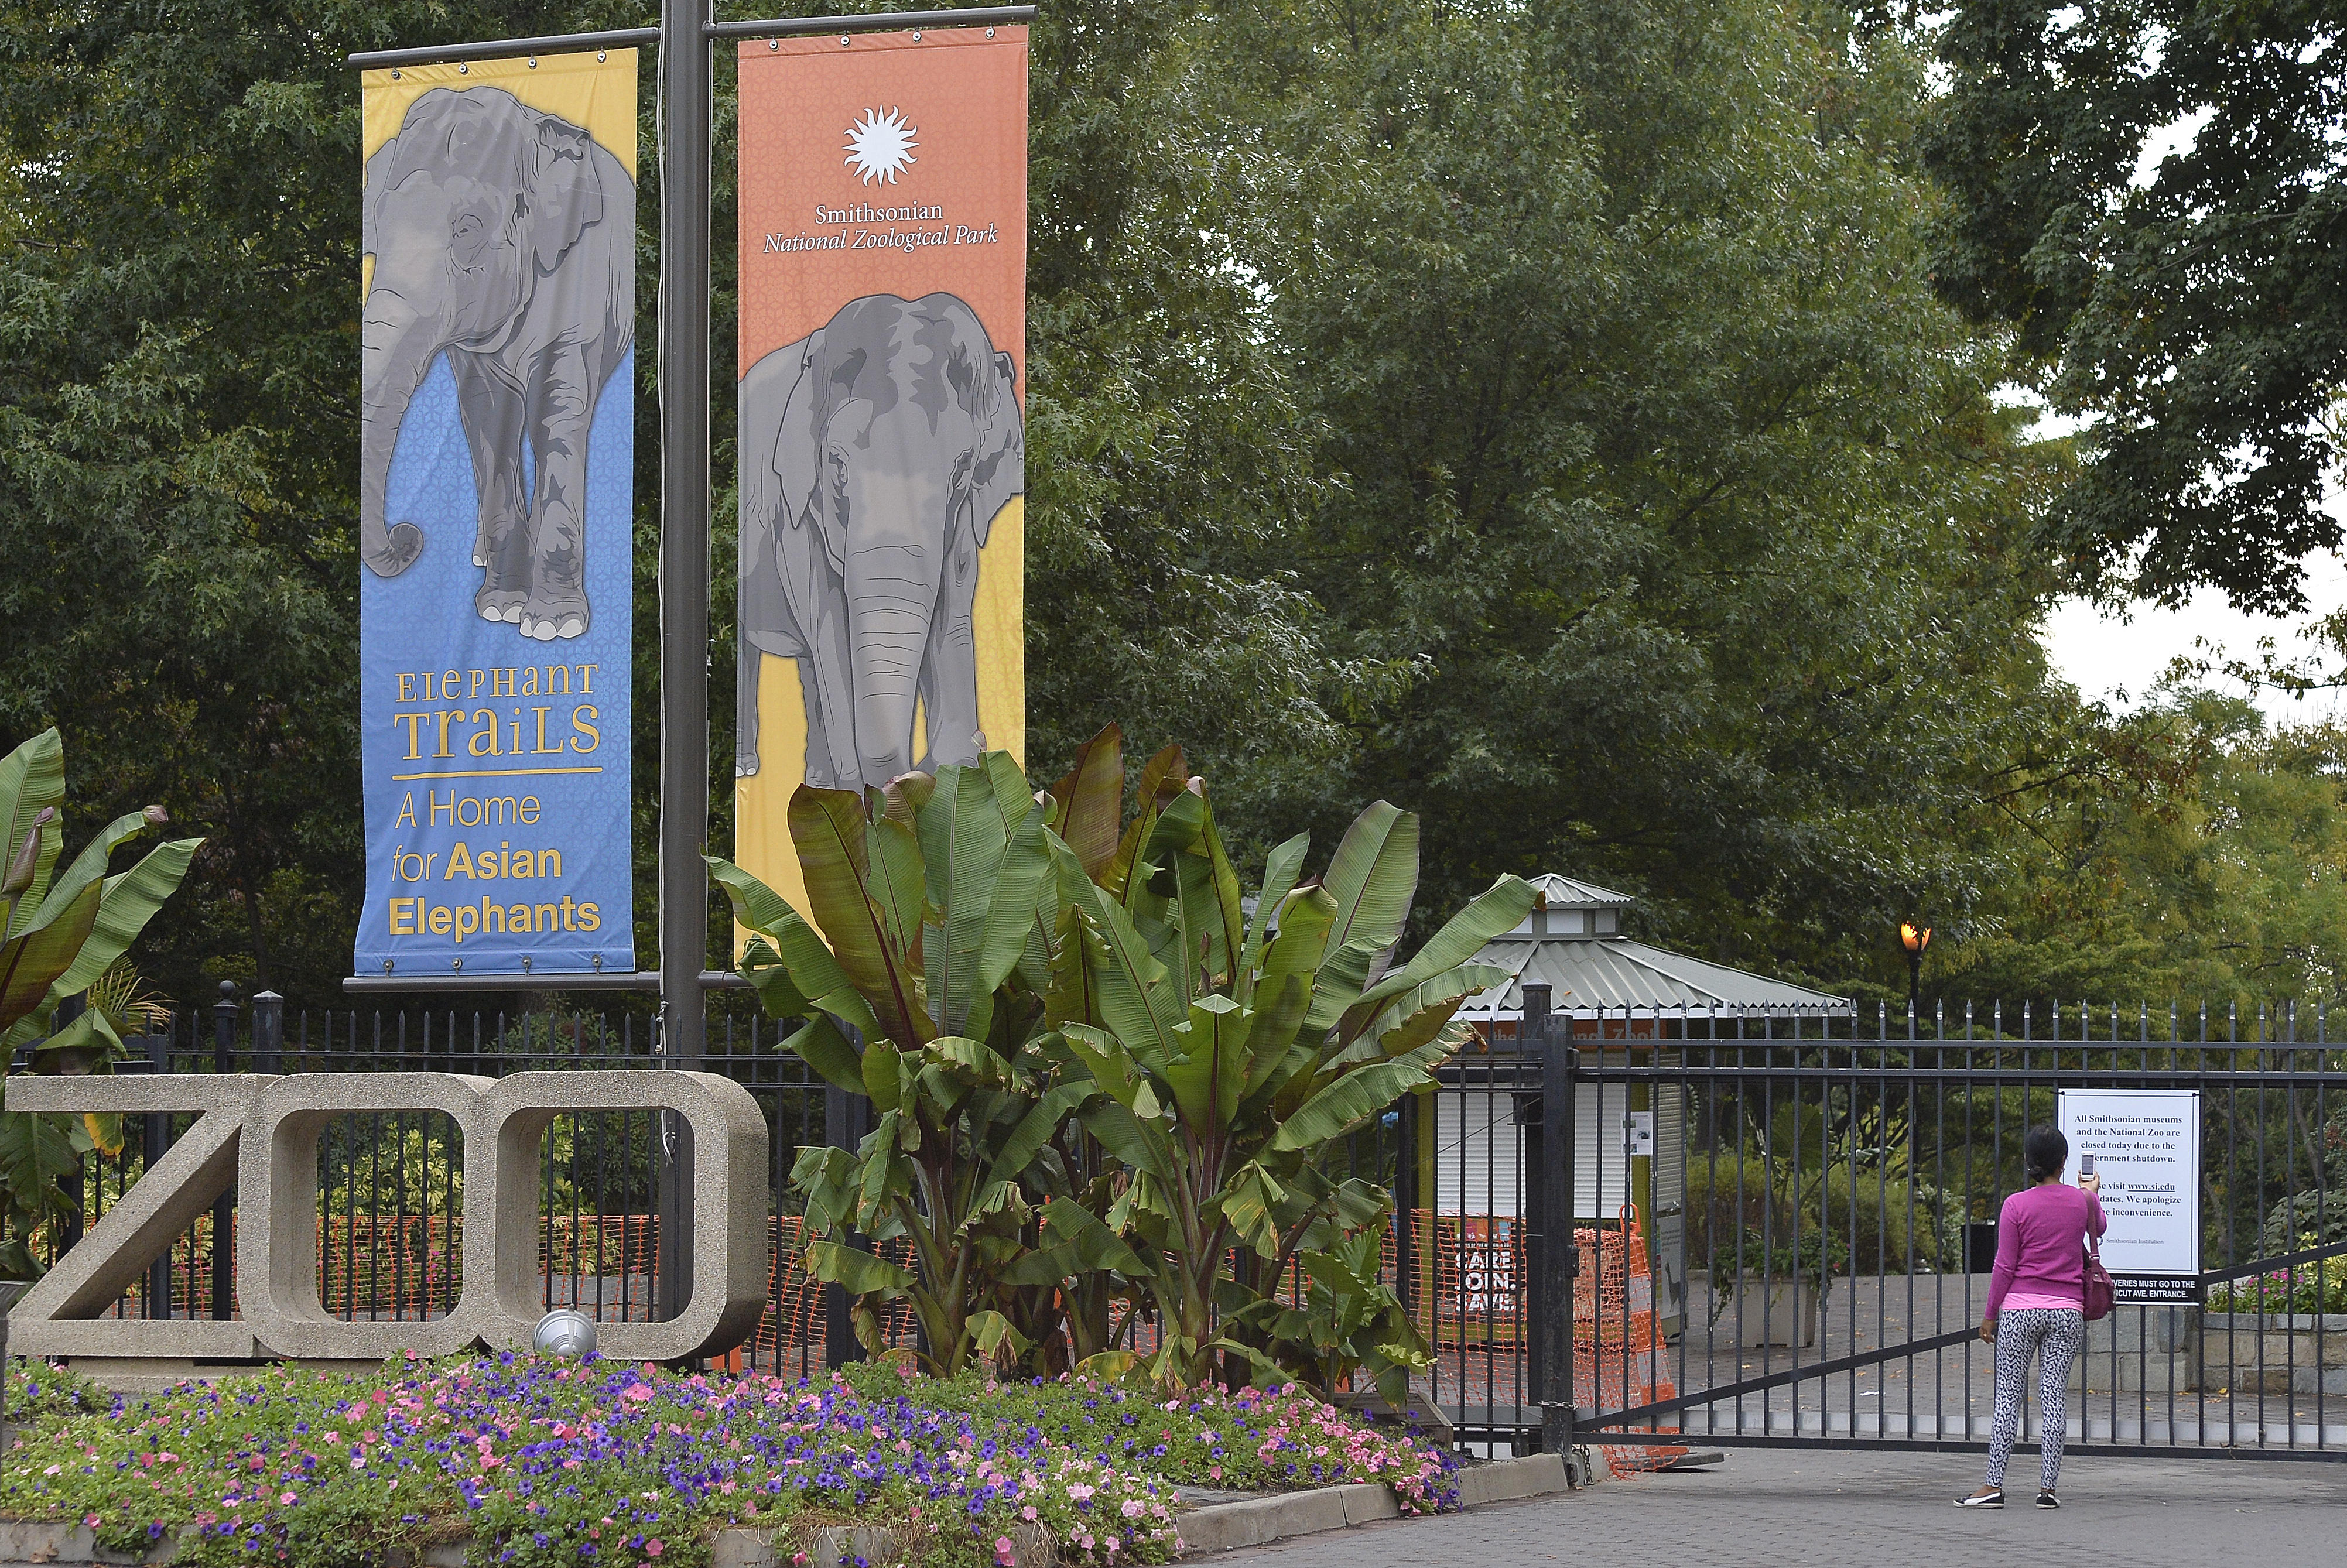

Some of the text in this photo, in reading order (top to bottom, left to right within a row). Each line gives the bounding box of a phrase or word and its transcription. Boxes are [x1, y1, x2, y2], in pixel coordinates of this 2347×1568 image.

[815, 201, 943, 224] Smithsonian
[763, 222, 998, 253] National Zoological Park
[395, 789, 541, 828] A Home
[391, 841, 562, 882] for Asian
[389, 895, 601, 943] Elephants
[2089, 1115, 2140, 1123] Smithsonian
[2109, 1142, 2132, 1151] today
[2128, 1183, 2175, 1192] www.si.edu
[2113, 1208, 2173, 1216] inconvenience.
[2142, 1196, 2181, 1205] apologize
[5, 1070, 768, 1360] ZOO
